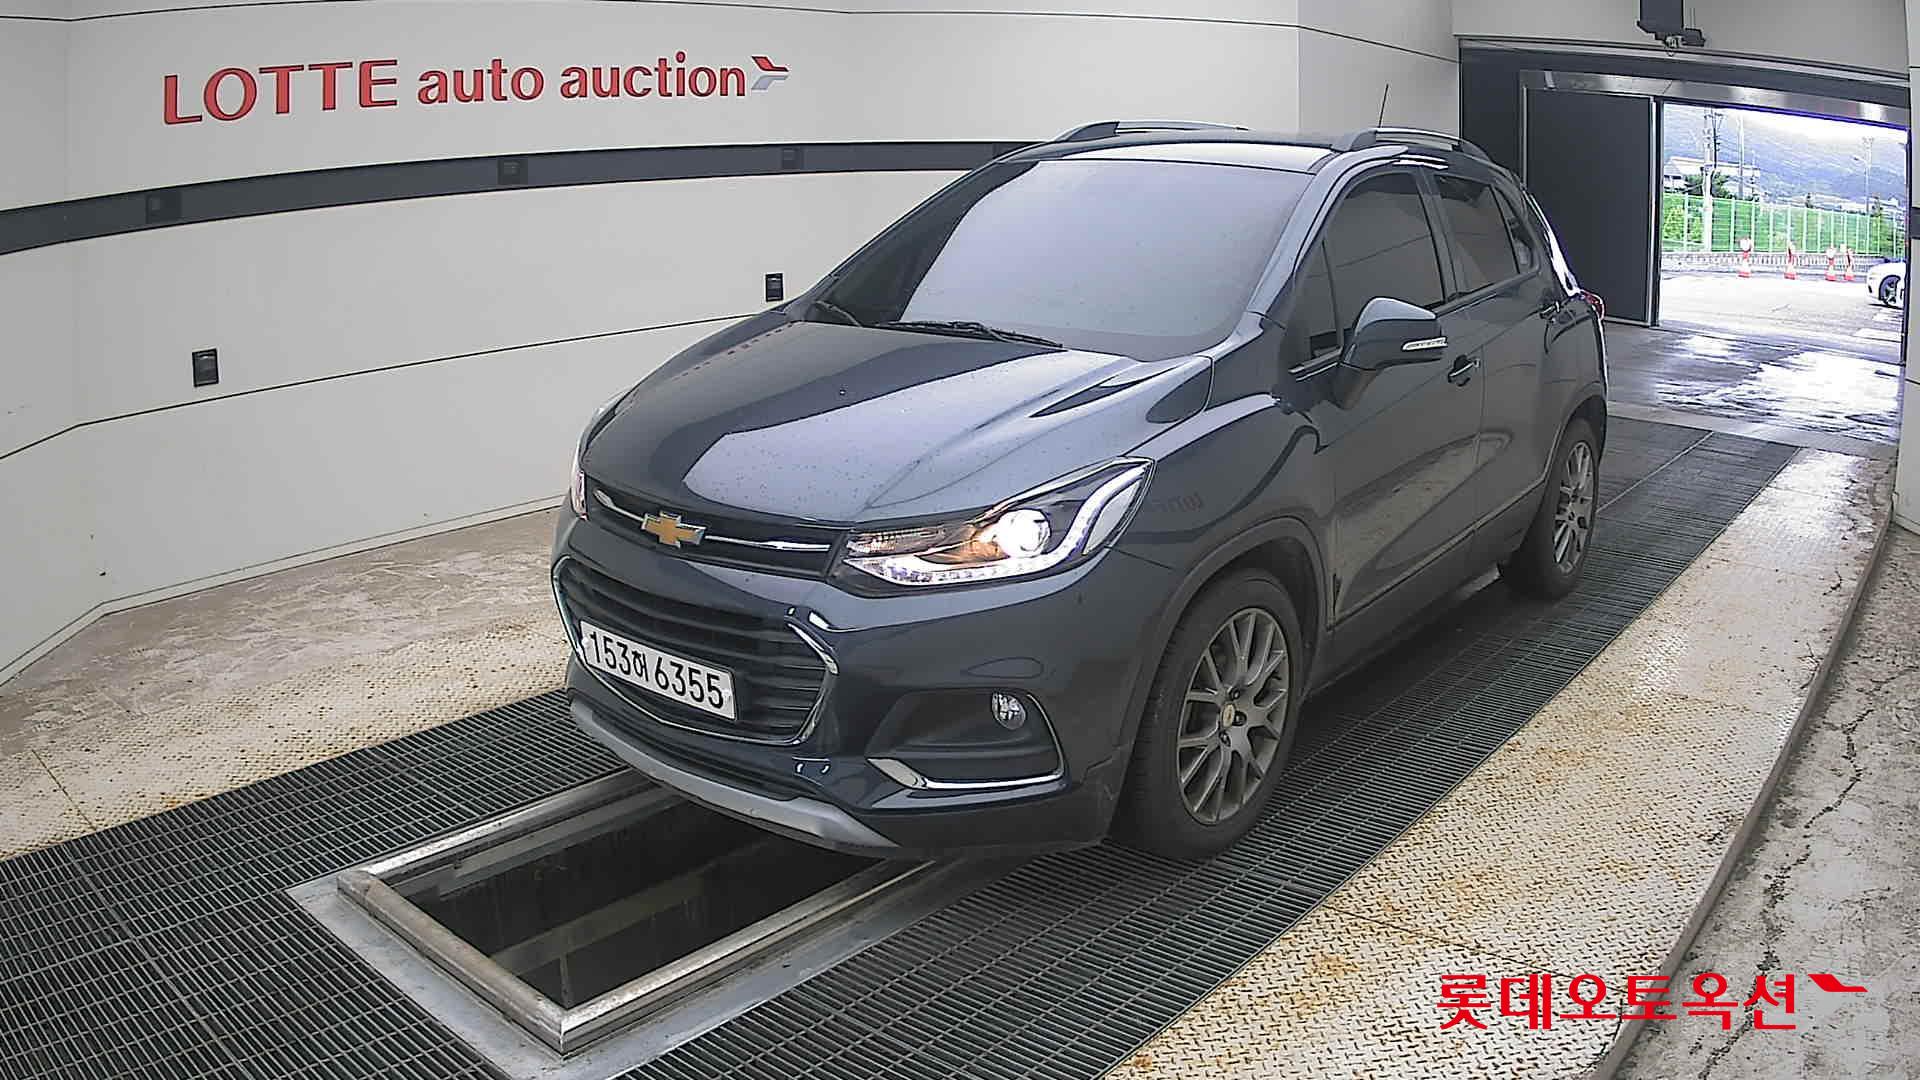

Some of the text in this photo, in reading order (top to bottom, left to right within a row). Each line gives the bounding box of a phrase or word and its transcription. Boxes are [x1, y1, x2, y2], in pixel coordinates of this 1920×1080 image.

[163, 51, 747, 126] LOTTE auto auction
[590, 631, 723, 709] 153허 6355
